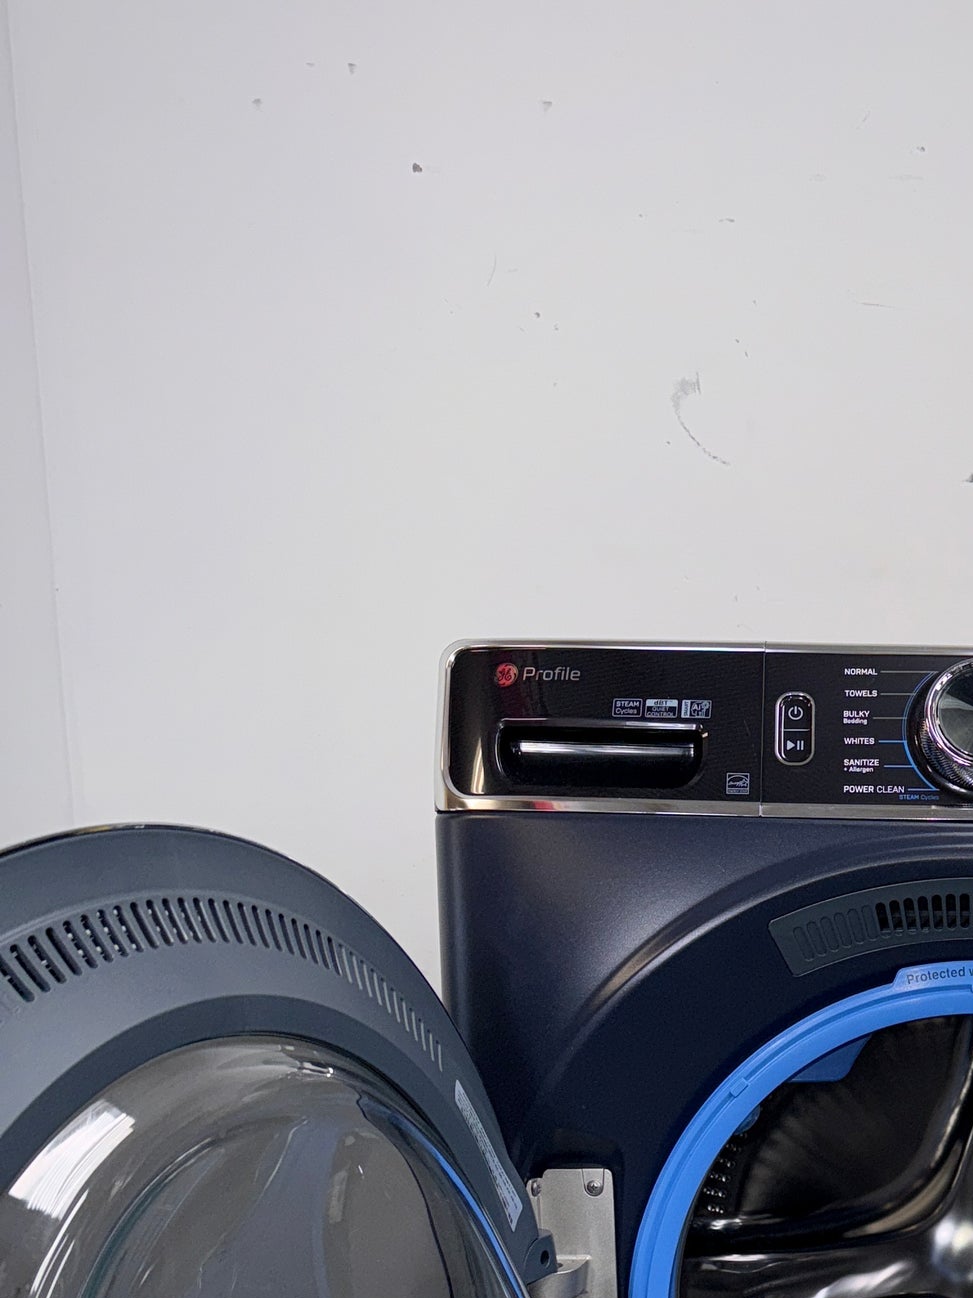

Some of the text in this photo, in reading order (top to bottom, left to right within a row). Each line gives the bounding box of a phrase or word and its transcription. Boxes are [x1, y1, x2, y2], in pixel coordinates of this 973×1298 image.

[522, 666, 581, 681] Profile
[844, 737, 875, 745] WHITES
[848, 766, 874, 774] Allergen
[843, 785, 905, 793] POWER CLEAN
[906, 966, 966, 985] Protected
